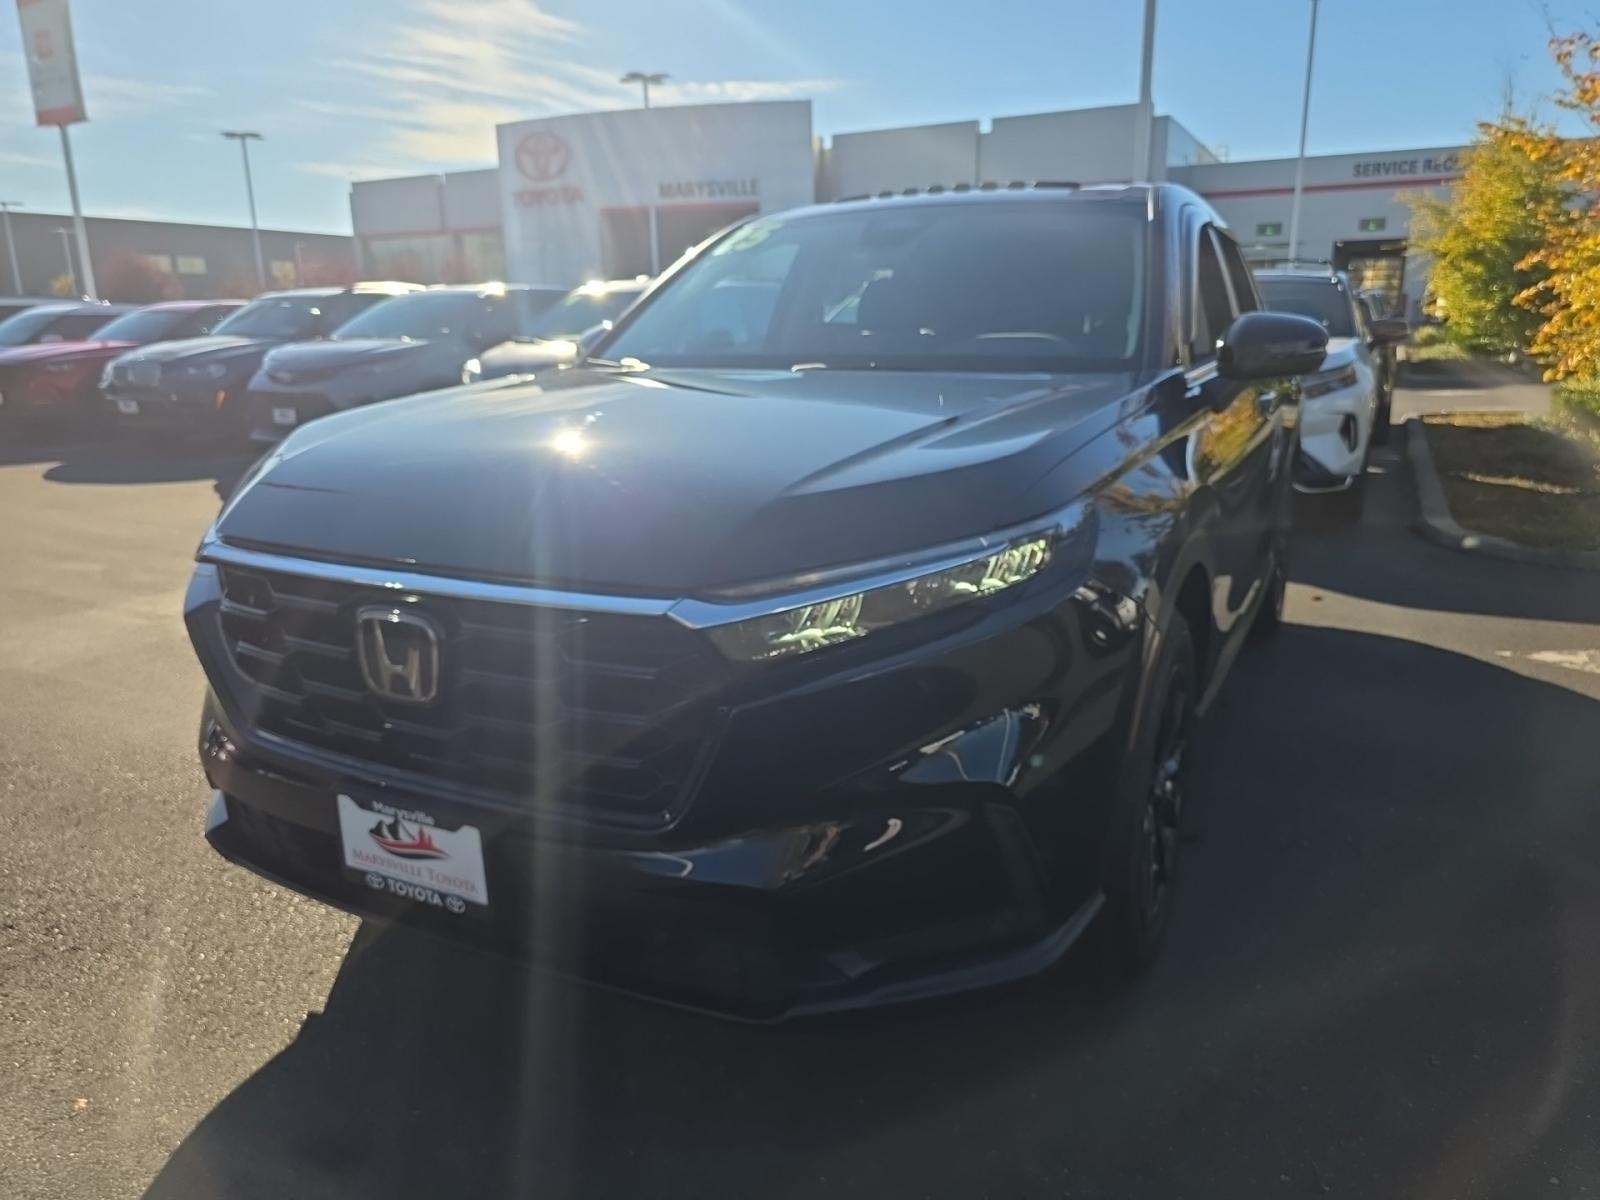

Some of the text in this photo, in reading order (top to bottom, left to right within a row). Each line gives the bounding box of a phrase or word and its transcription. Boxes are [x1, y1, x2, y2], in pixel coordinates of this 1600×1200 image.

[1352, 160, 1418, 178] SERVICE
[657, 178, 760, 199] MARYSVILLE
[387, 878, 443, 907] TOYOTA
